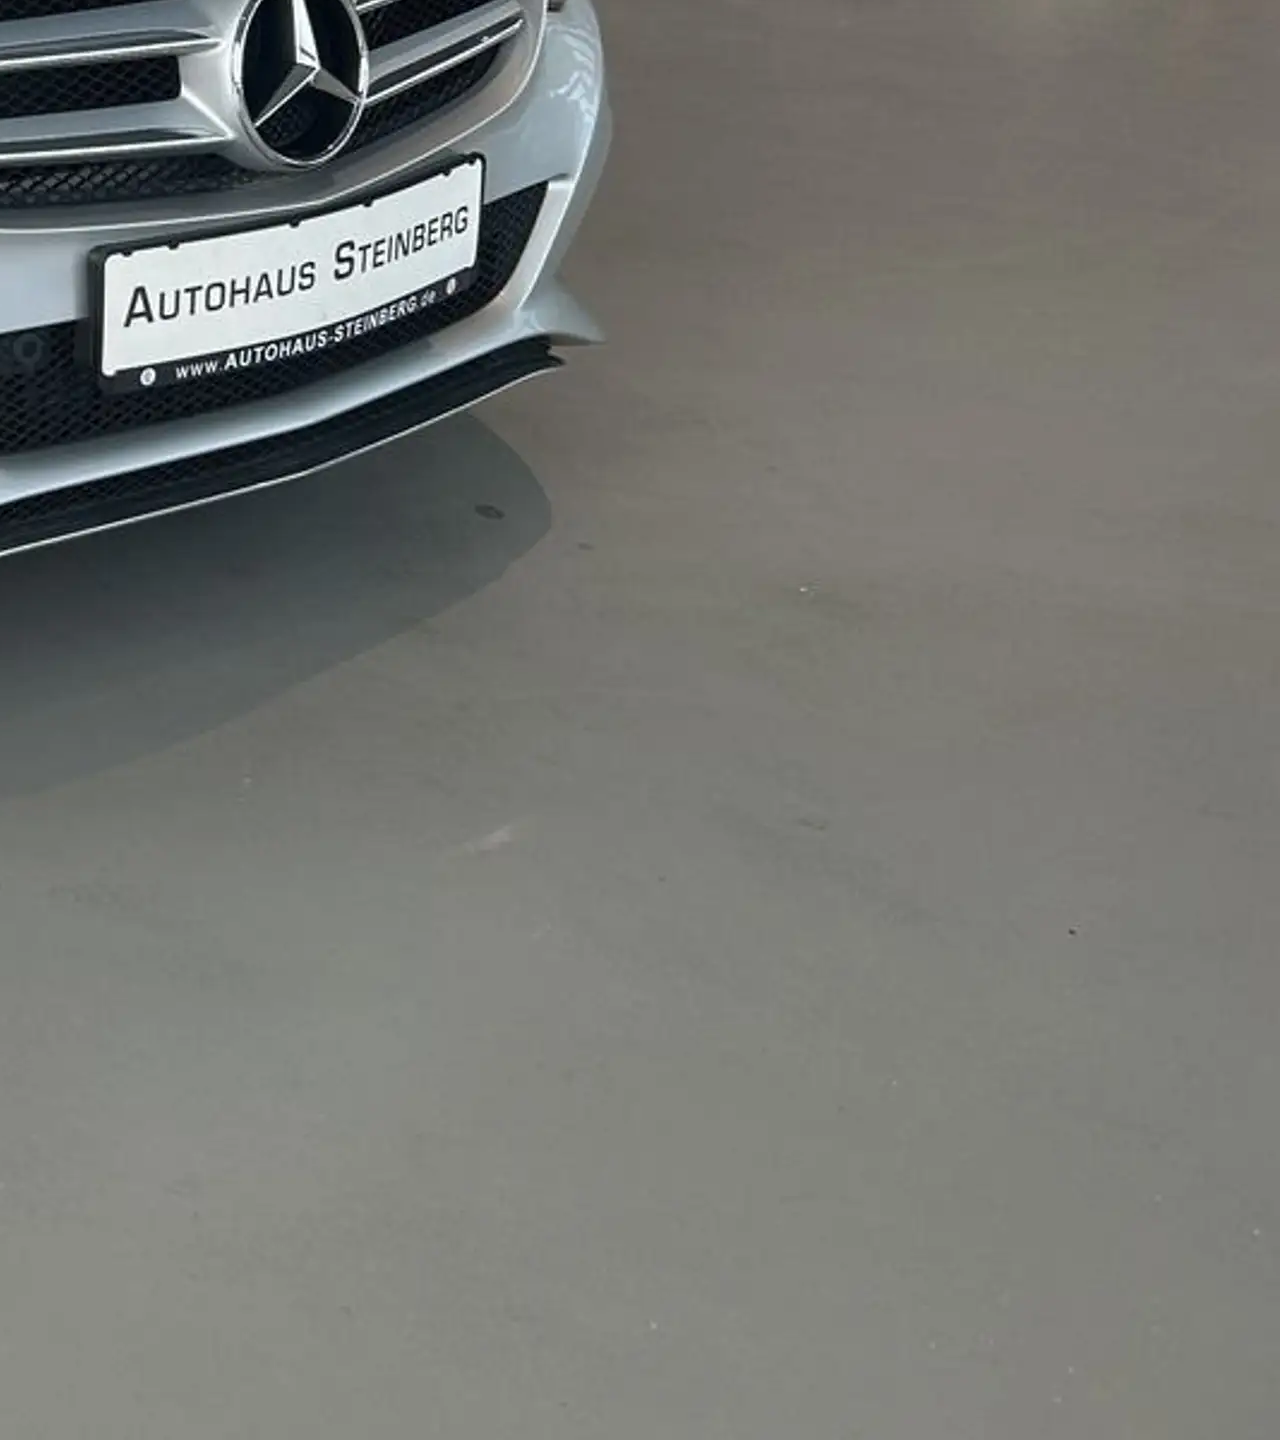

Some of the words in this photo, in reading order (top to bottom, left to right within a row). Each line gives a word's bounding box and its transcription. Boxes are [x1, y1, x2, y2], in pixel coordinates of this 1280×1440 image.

[123, 260, 316, 327] AUTOHAUS
[333, 206, 469, 280] STEINBERG
[175, 289, 437, 380] www.AUTOHAUS-STEINBERG.de
